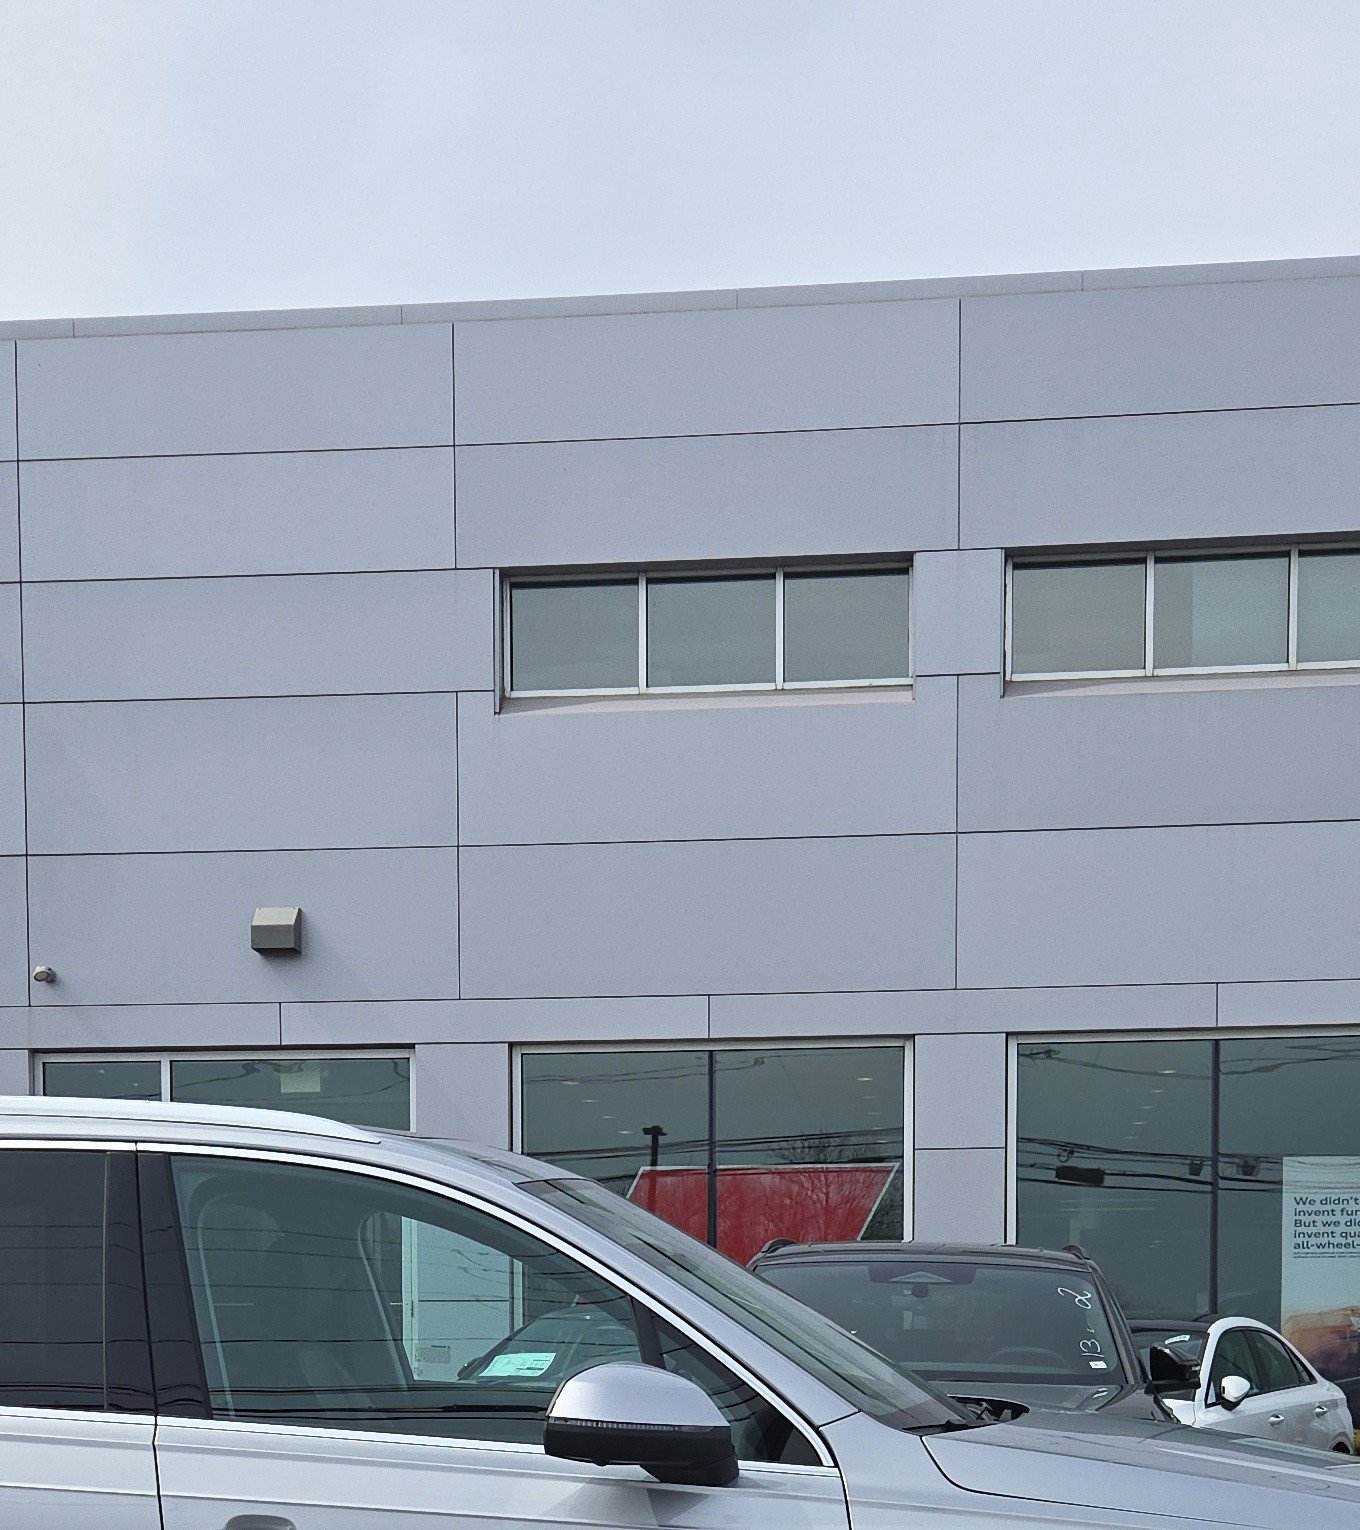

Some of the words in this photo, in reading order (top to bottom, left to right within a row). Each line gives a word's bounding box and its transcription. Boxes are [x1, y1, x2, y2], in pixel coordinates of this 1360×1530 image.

[1294, 1196, 1316, 1206] We
[1320, 1196, 1360, 1206] didn't
[1294, 1207, 1337, 1217] invent
[1294, 1218, 1319, 1228] But
[1321, 1220, 1341, 1228] we
[1293, 1229, 1337, 1239] invent
